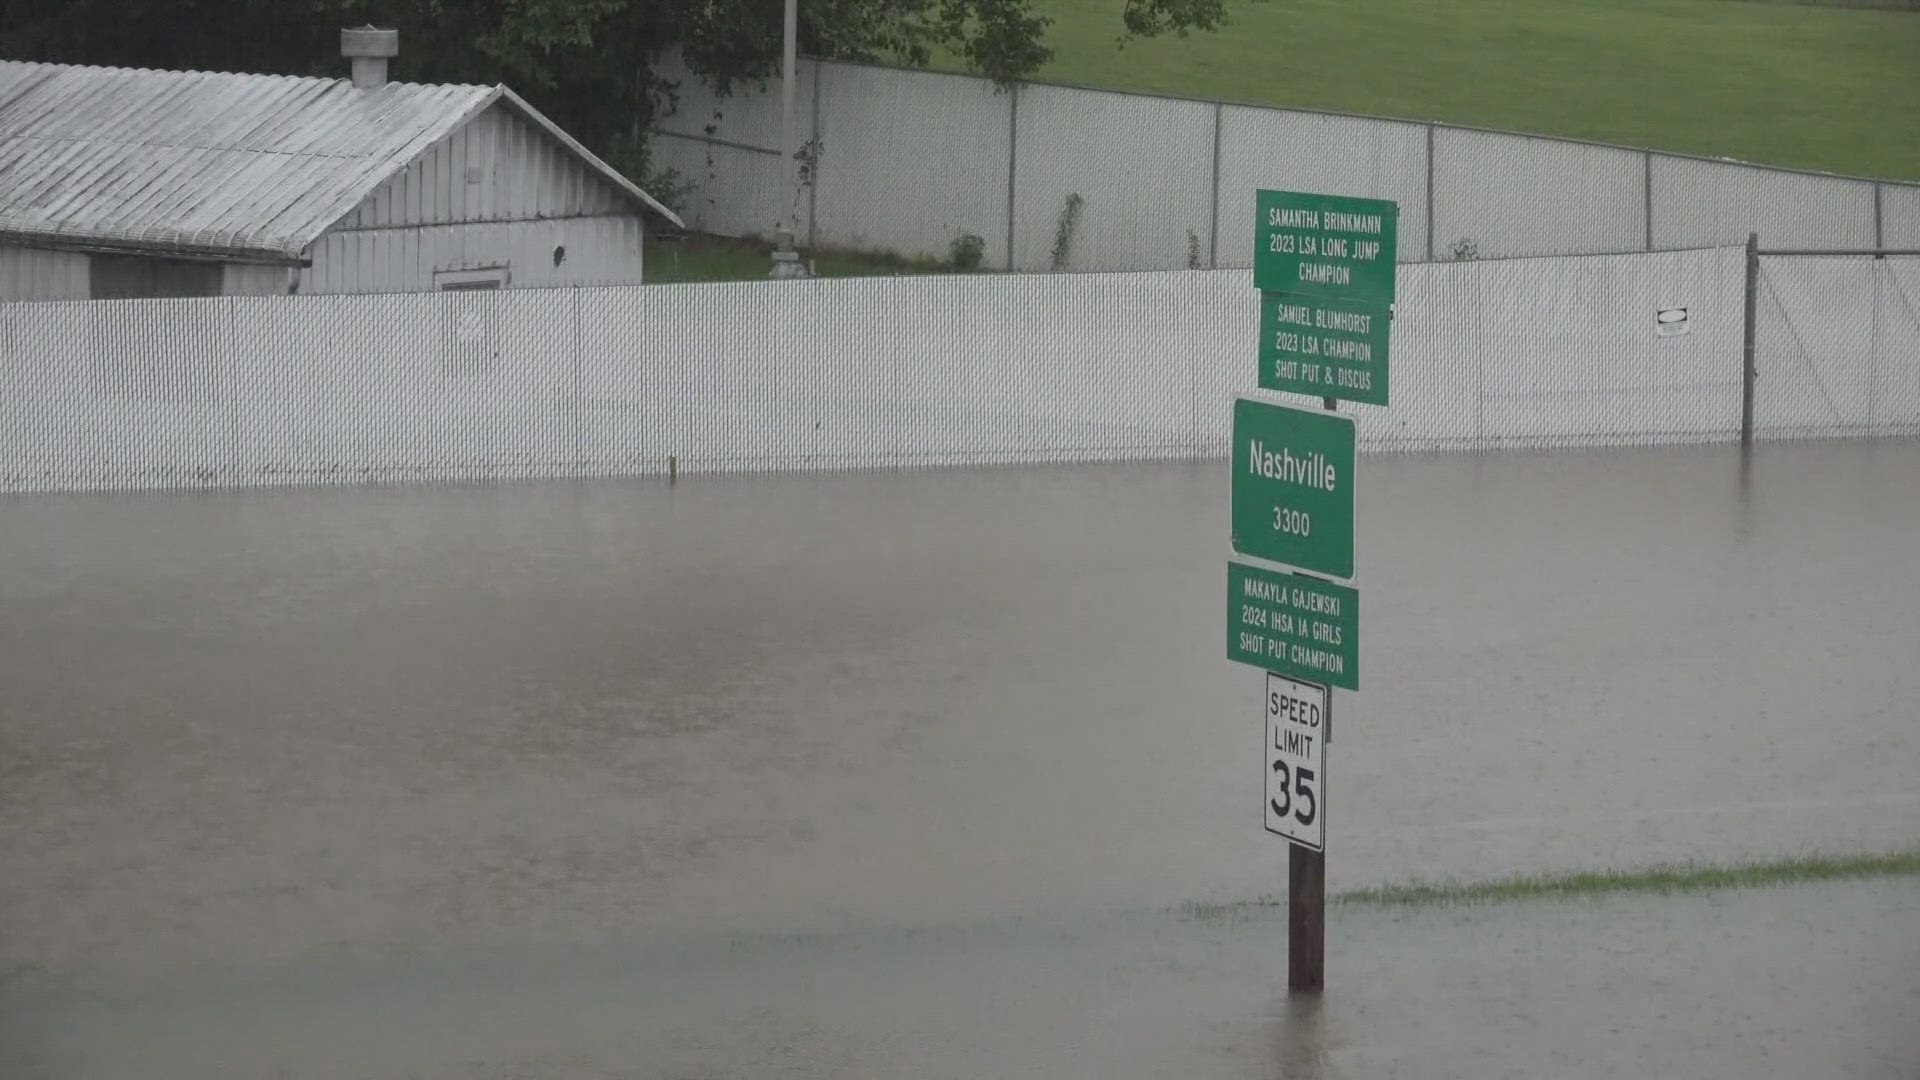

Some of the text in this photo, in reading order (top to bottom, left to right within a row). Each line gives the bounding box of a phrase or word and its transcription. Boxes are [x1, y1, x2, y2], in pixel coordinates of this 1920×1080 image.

[1269, 207, 1381, 235] SAMANTHA BRINKMANN
[1270, 233, 1380, 261] 2023 LSA LONG JUMP
[1299, 262, 1350, 286] CHAMPION
[1278, 303, 1371, 334] SAMUEL BLUMHORST
[1276, 331, 1371, 362] 2023 LSA CHAMPION
[1275, 359, 1371, 391] SHOT PUT & DISCUS
[1250, 438, 1336, 491] Nashville
[1273, 506, 1309, 537] 3300
[1244, 578, 1340, 617] MAKAYLA GAJEWSKI
[1242, 604, 1266, 628] 2024
[1271, 611, 1293, 635] IHSA
[1313, 621, 1342, 645] GIRLS
[1240, 632, 1343, 674] SHOT PUT CHAMPION
[1270, 691, 1320, 728] SPEED
[1275, 725, 1313, 760] LIMIT
[1271, 759, 1316, 827] 35
